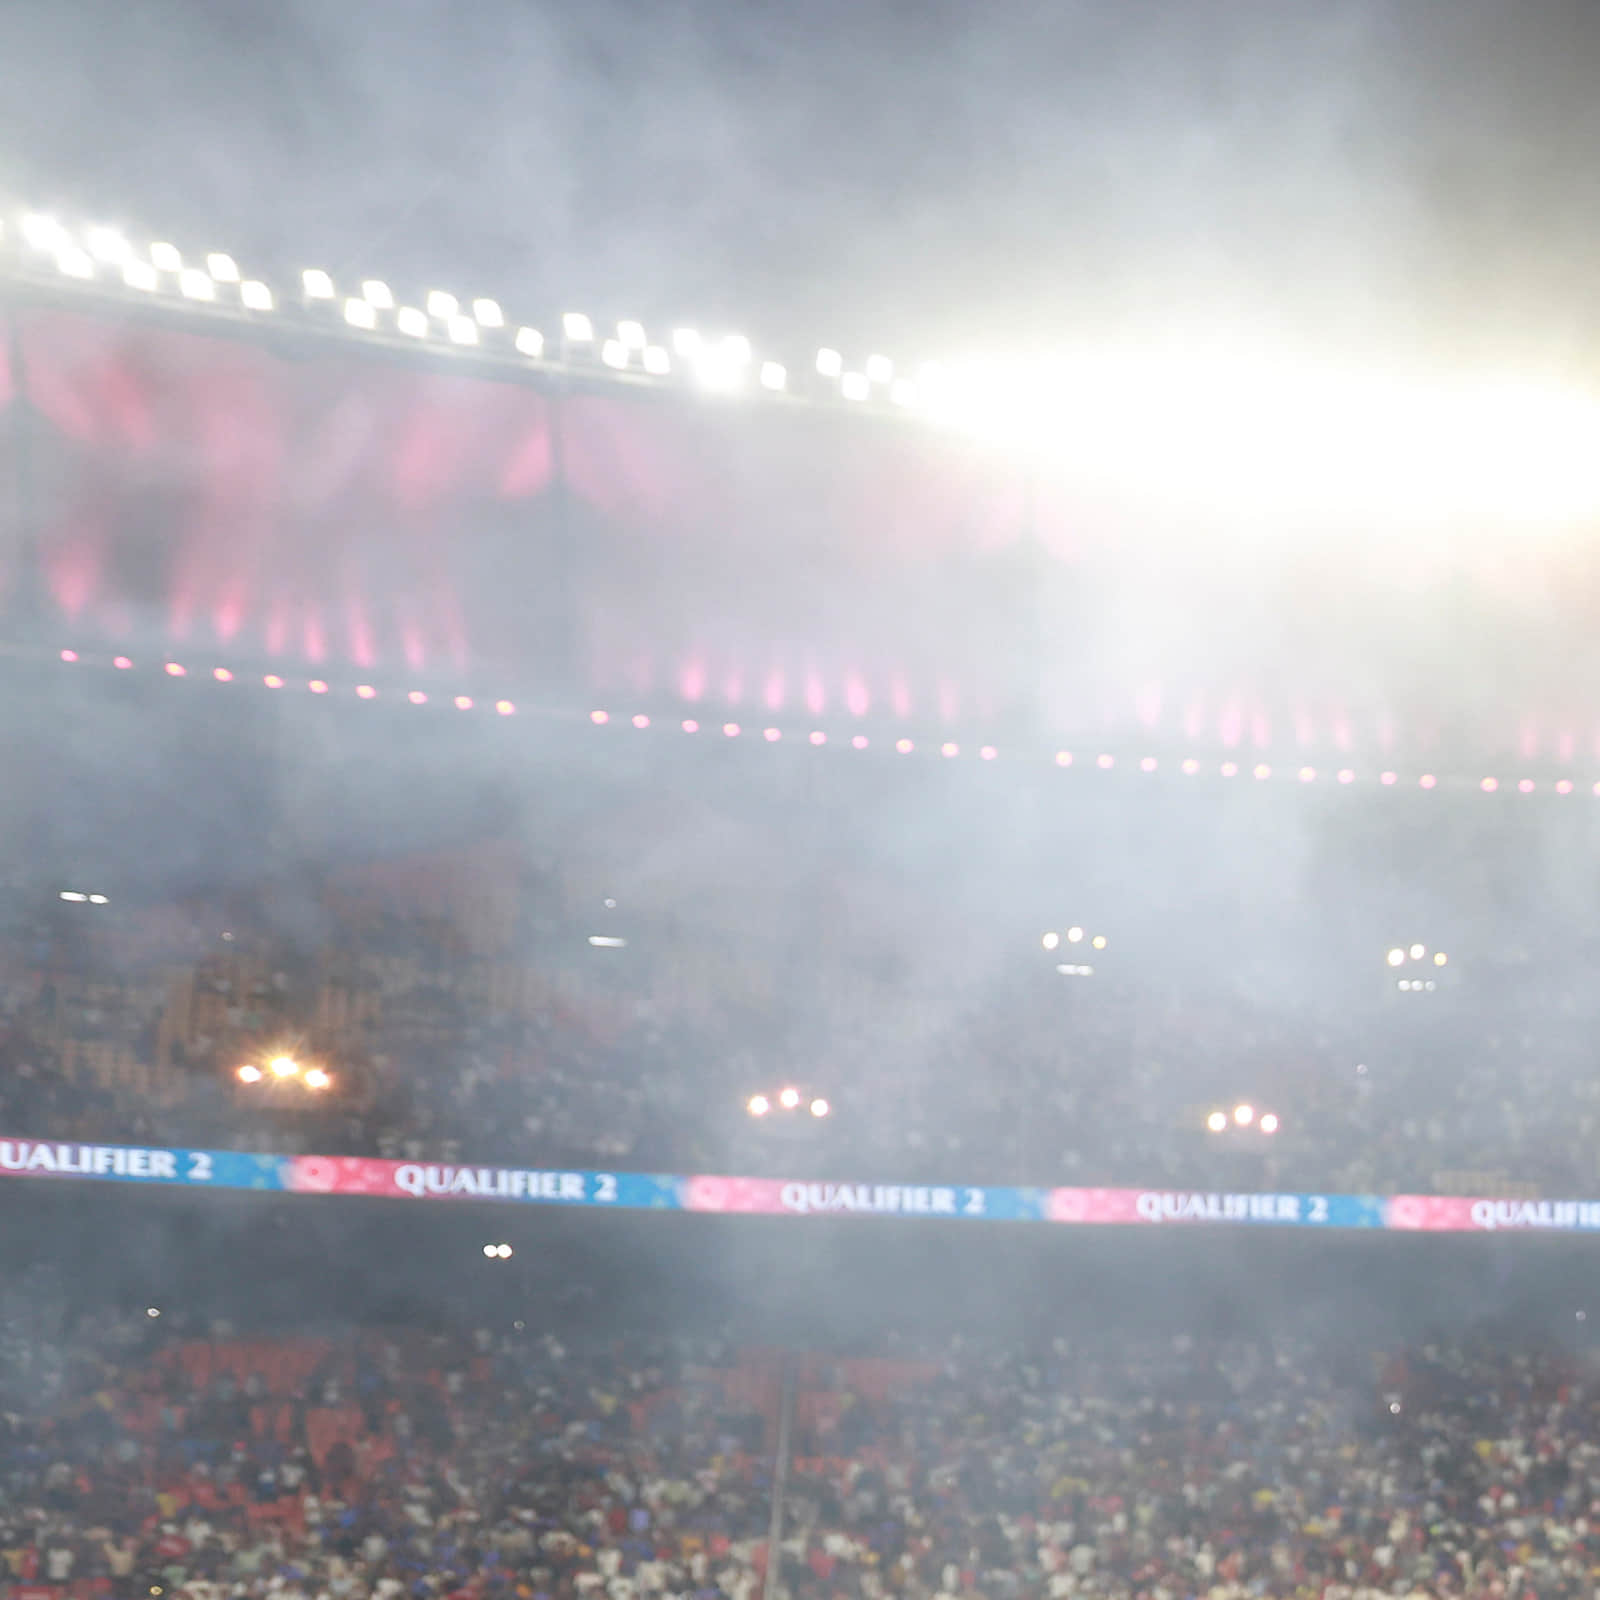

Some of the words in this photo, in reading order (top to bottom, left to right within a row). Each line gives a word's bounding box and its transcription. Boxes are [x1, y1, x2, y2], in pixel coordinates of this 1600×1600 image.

[0, 1142, 177, 1177] UALIFIER
[188, 1153, 213, 1180] 2
[394, 1164, 585, 1199] QUALIFIER
[594, 1174, 617, 1201] 2
[780, 1182, 955, 1214] QUALIFIER
[964, 1188, 986, 1215] 2
[1136, 1190, 1301, 1222] QUALIFIER
[1307, 1196, 1329, 1223] 2
